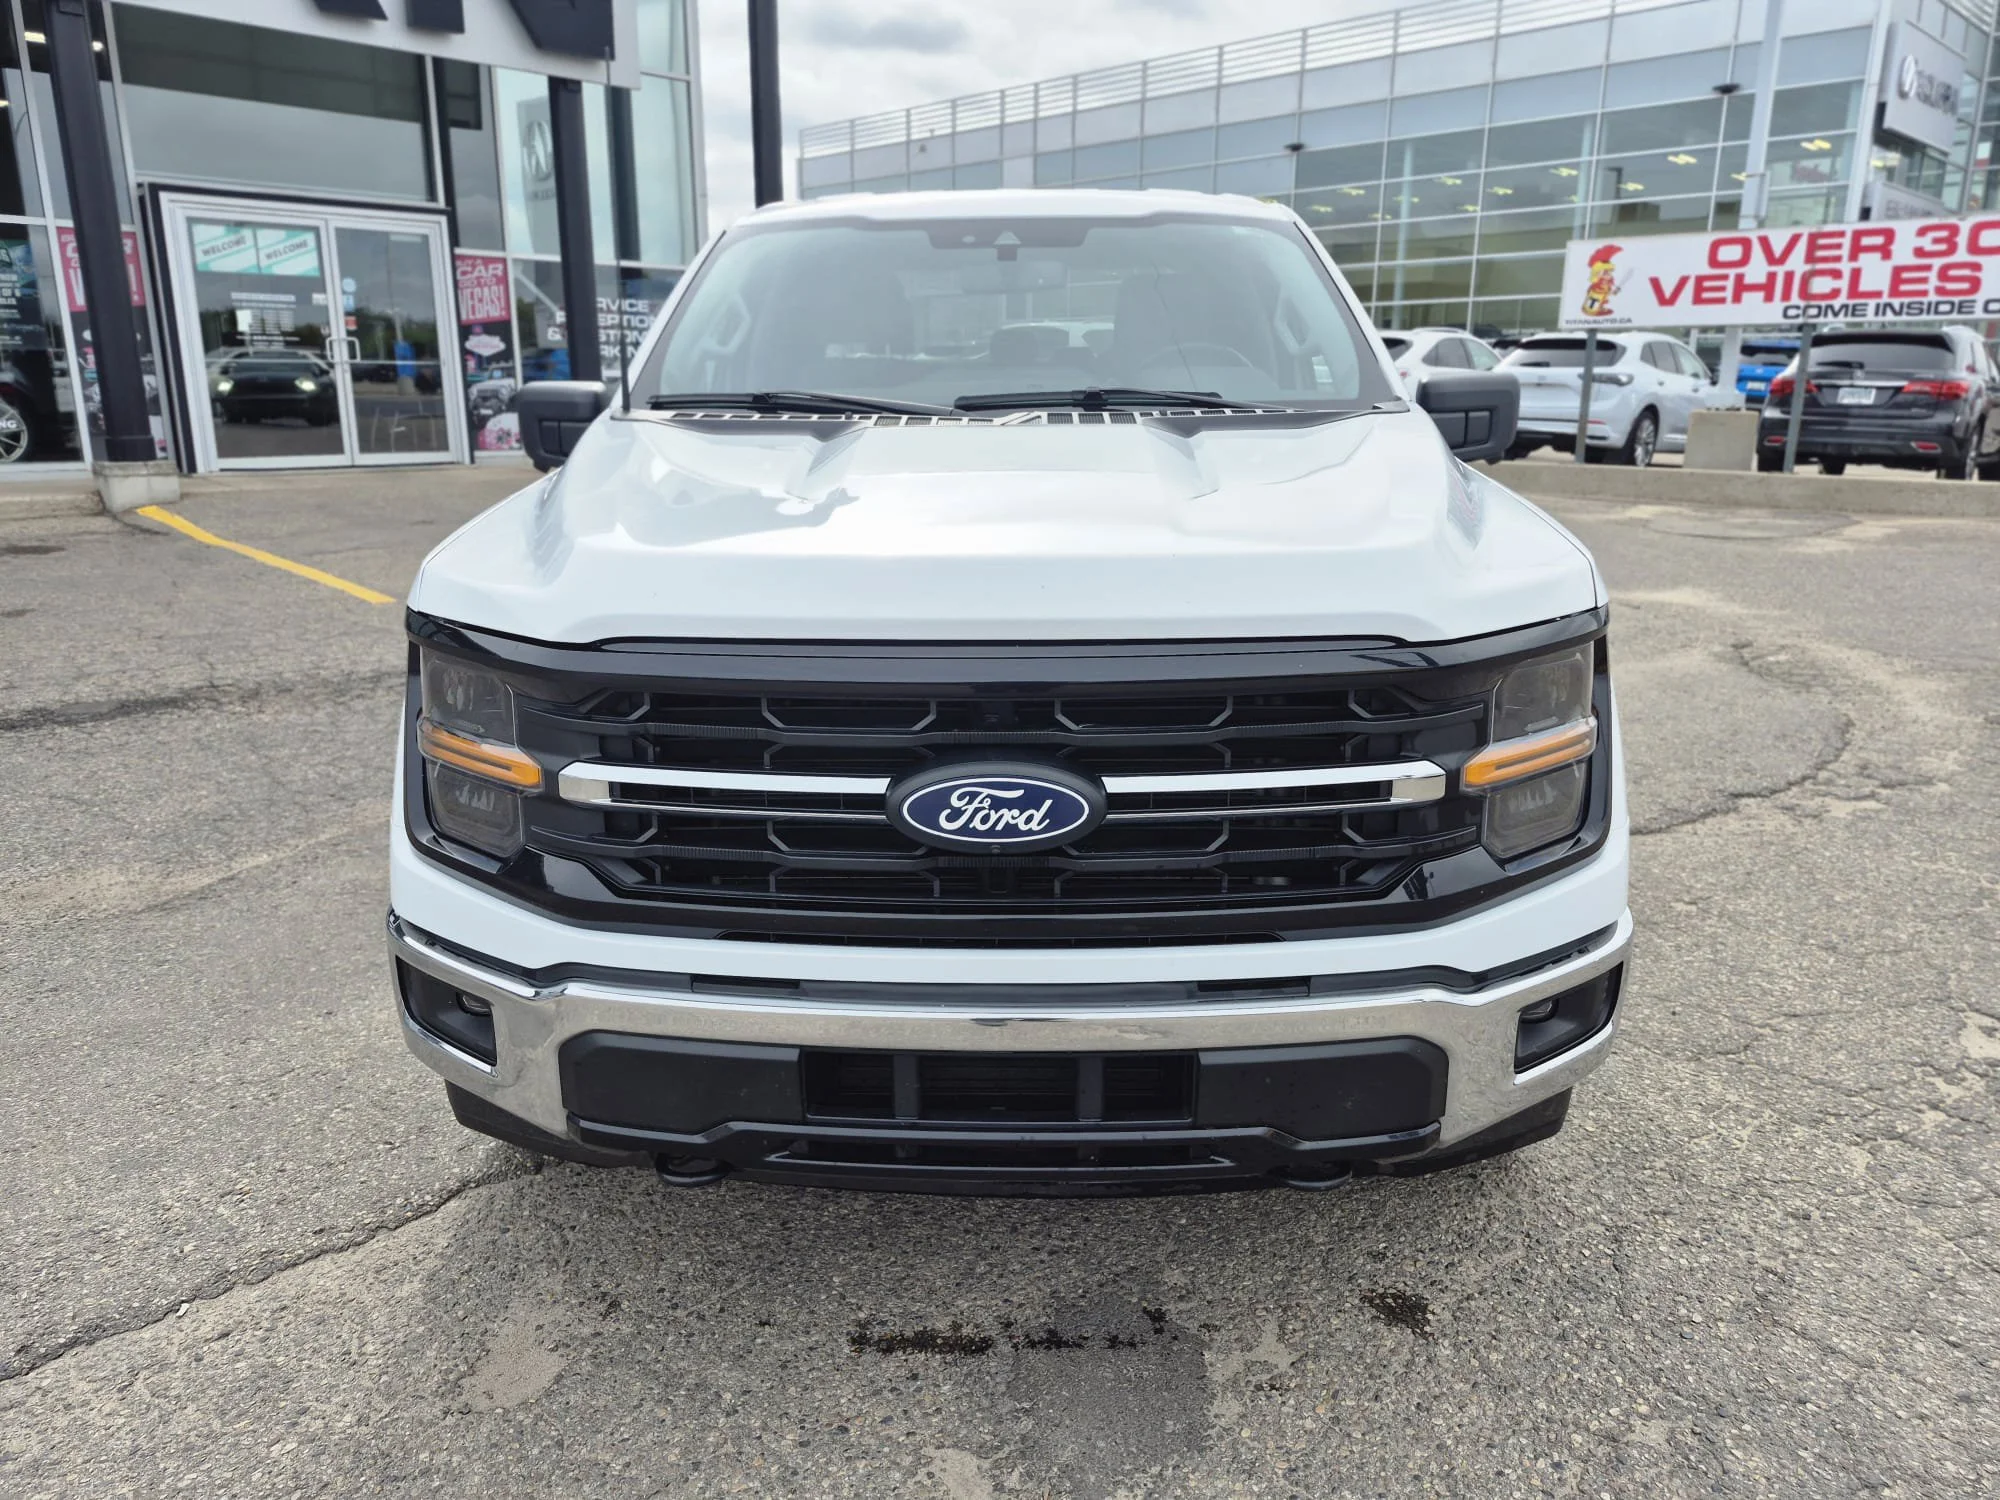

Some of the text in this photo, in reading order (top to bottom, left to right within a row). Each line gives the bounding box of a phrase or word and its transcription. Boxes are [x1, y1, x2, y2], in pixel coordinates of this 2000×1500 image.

[202, 235, 247, 257] WELCOME
[264, 239, 309, 260] WELCOME
[1708, 227, 1896, 270] OVER
[457, 264, 504, 280] CAR
[1649, 261, 1983, 307] VEHICLES
[458, 285, 506, 320] VEGAS!
[596, 298, 649, 313] RVICE
[1782, 301, 1869, 320] COME
[1874, 299, 1977, 317] INSIDE
[938, 786, 1053, 831] Ford
